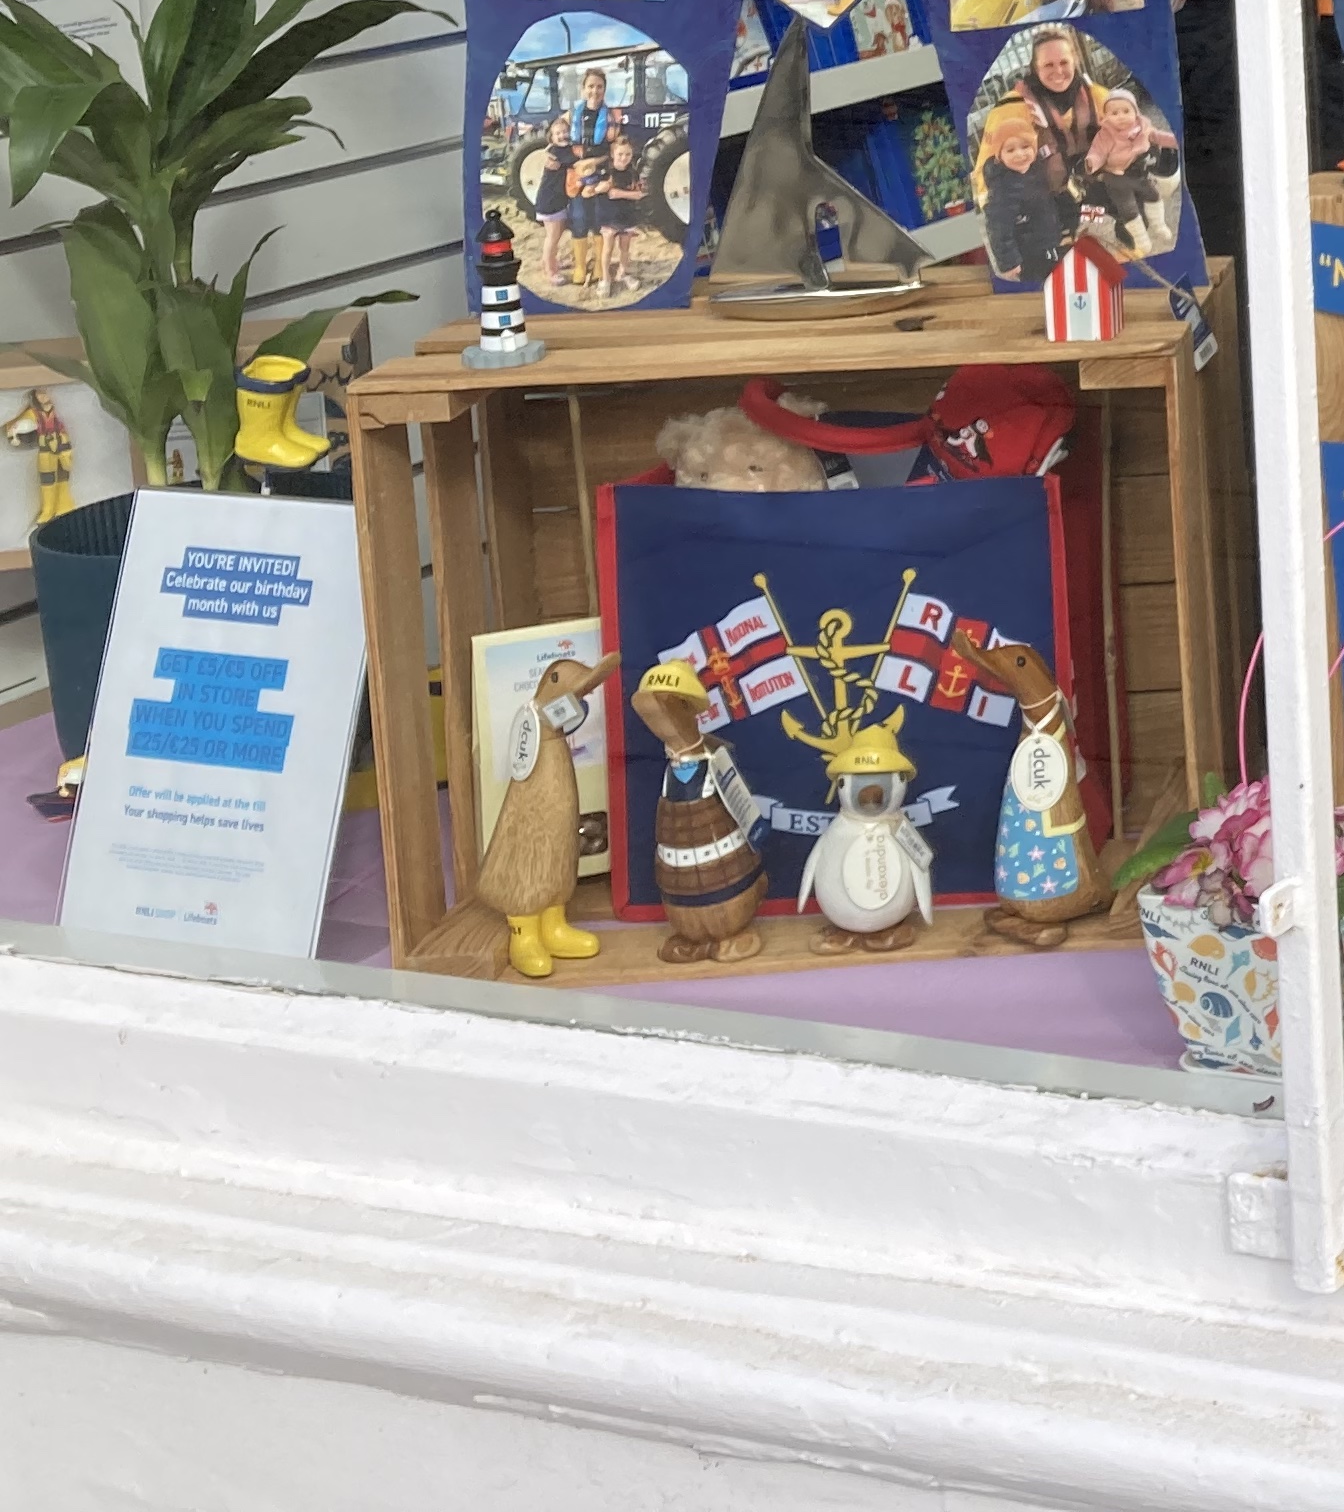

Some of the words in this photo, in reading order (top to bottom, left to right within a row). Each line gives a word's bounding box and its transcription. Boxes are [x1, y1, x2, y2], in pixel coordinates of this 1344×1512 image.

[246, 398, 272, 409] RNLI
[187, 551, 236, 571] YOU'RE
[238, 555, 297, 576] INVITED!
[165, 571, 227, 592] Celebrate
[229, 581, 253, 594] our
[254, 580, 310, 603] birthday
[186, 597, 229, 614] month
[231, 599, 259, 617] with
[262, 605, 279, 619] us
[160, 651, 195, 674] GET
[249, 661, 286, 683] OFF
[535, 649, 577, 663] Lifeboats
[646, 674, 681, 689] RNLI
[177, 684, 195, 702] IN
[200, 686, 258, 708] STORE
[134, 703, 187, 728] WHEN
[191, 709, 227, 733] YOU
[230, 714, 289, 739] SPEND
[202, 739, 229, 759] OR
[517, 719, 533, 762] dcuk
[853, 755, 881, 766] RNLI
[1033, 747, 1051, 790] dcuk
[129, 785, 152, 799] Offer
[154, 789, 172, 800] will
[174, 791, 184, 802] be
[124, 804, 144, 817] Your
[147, 808, 188, 825] shopping
[190, 813, 215, 828] helps
[217, 818, 239, 830] save
[241, 819, 264, 832] lives
[874, 835, 890, 902] alexandra
[184, 912, 218, 925] Lifeboats
[1190, 957, 1220, 976] RNLI
